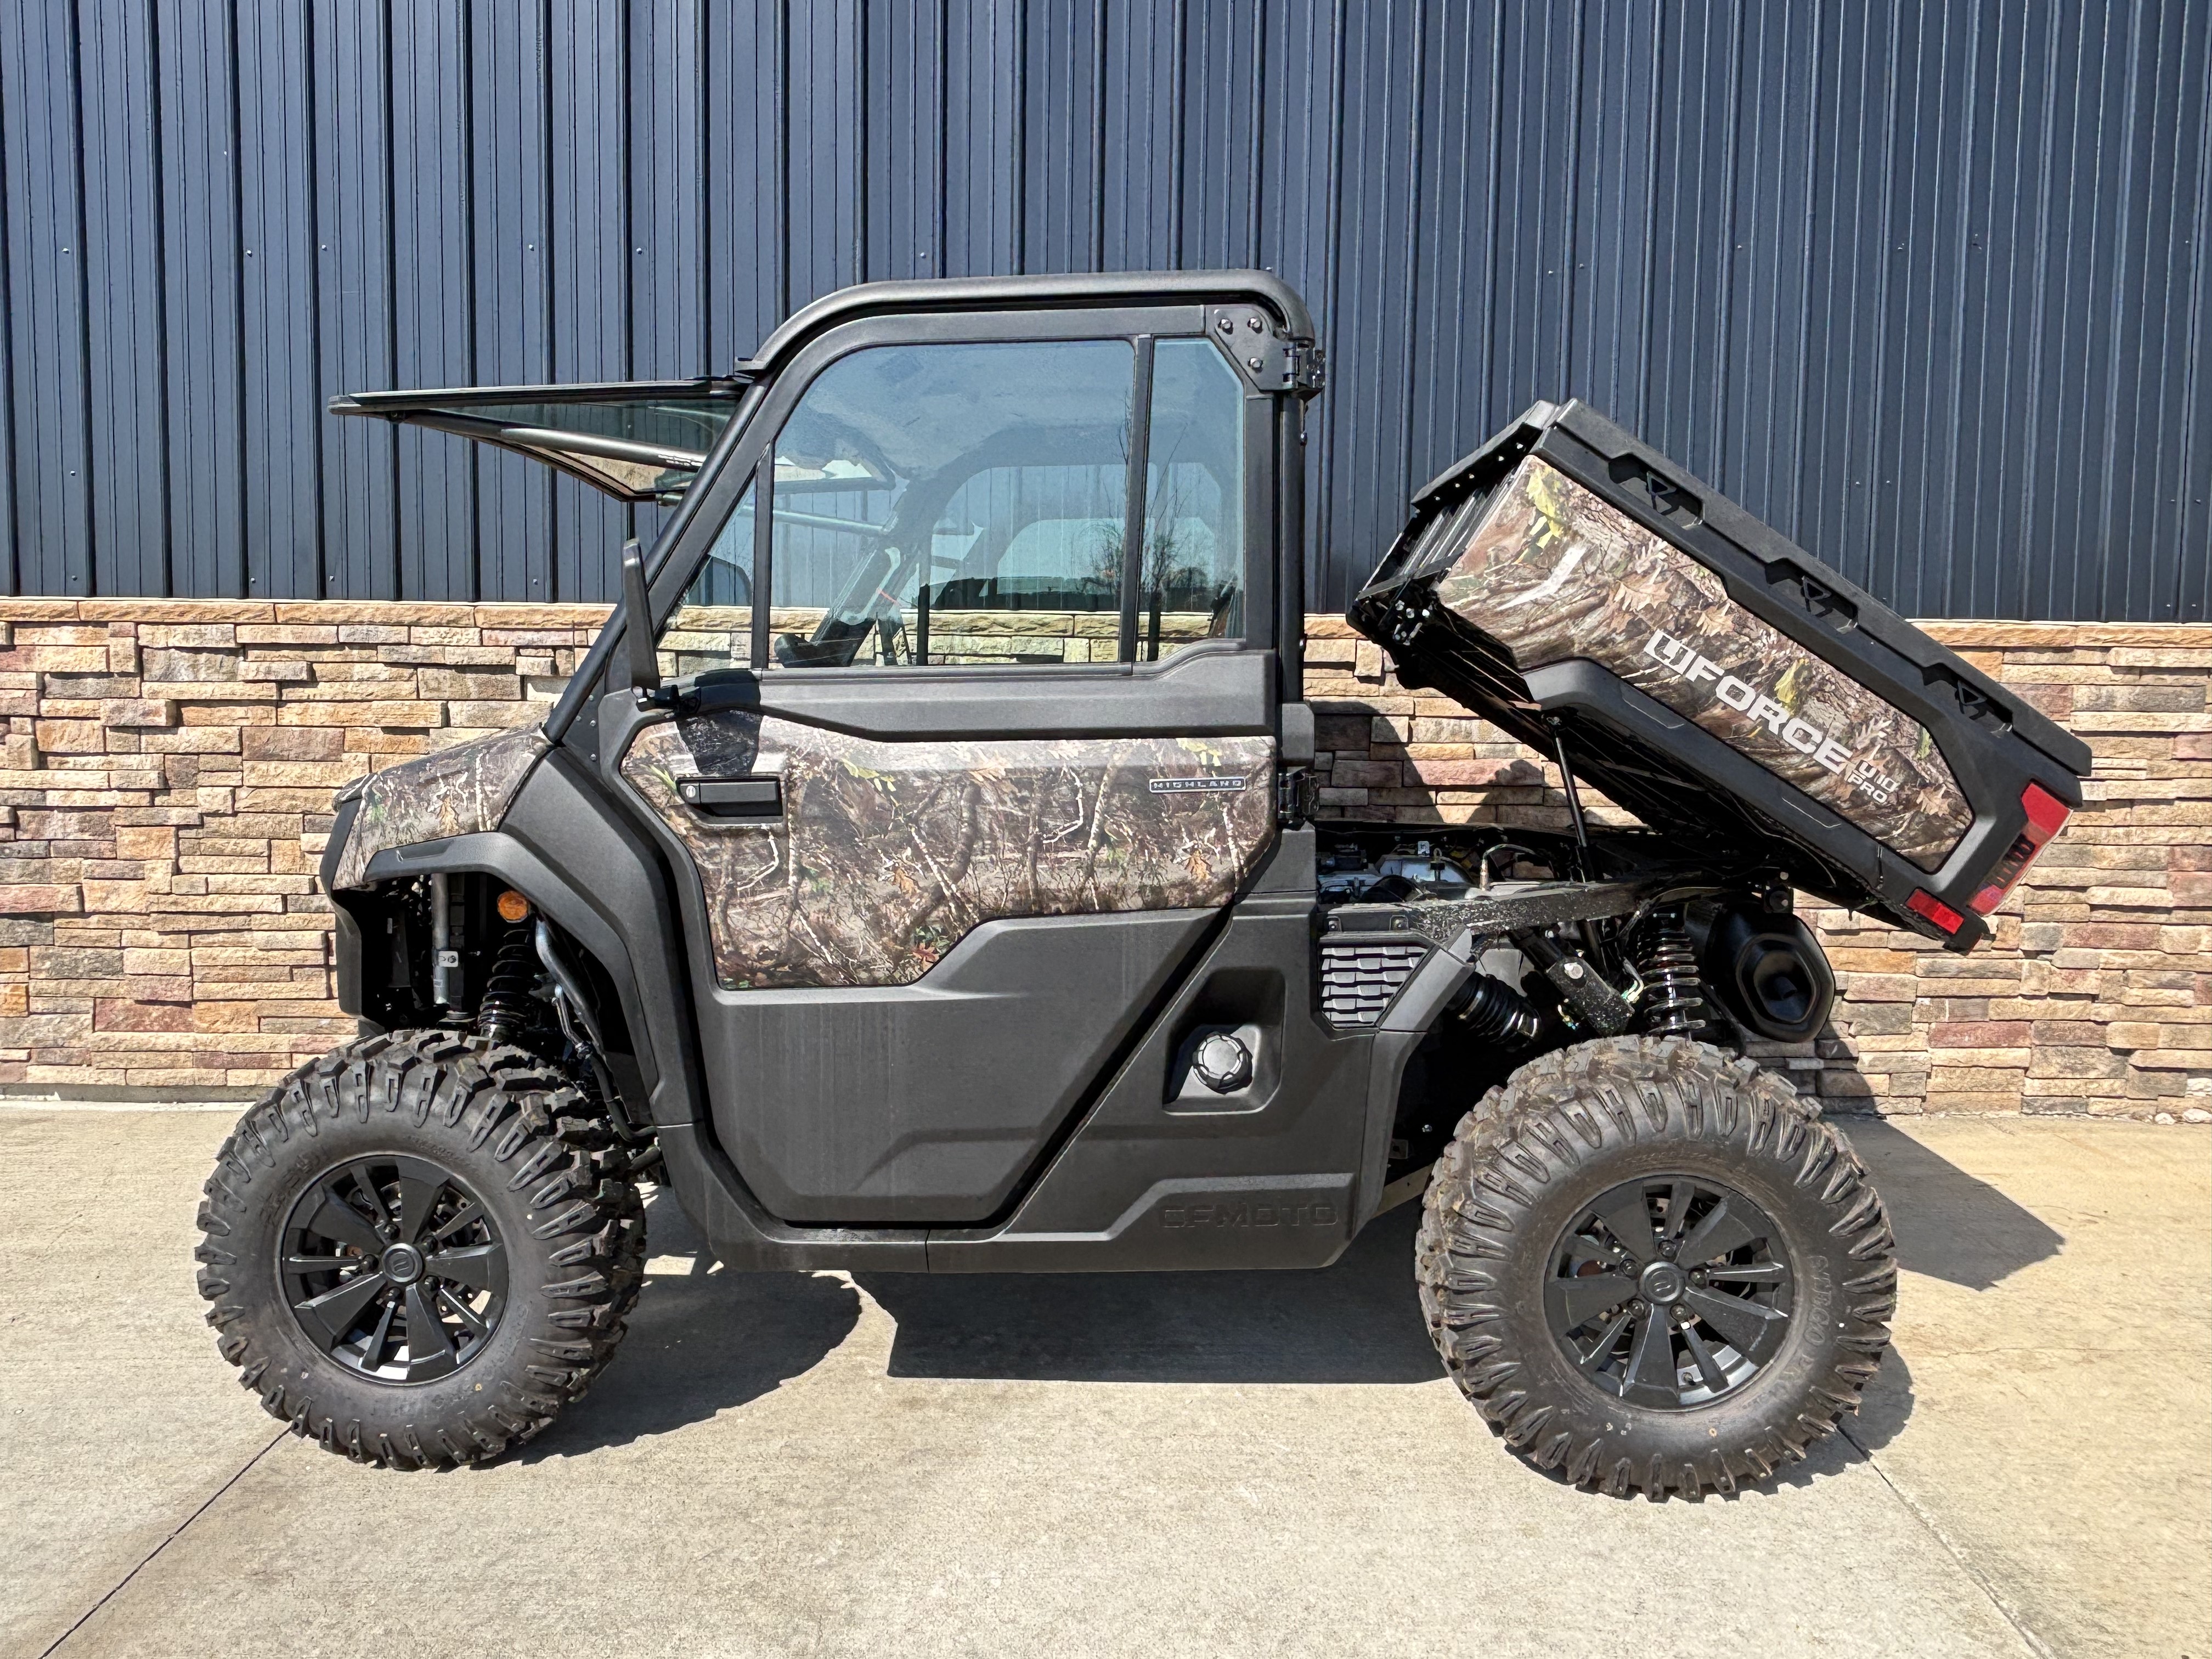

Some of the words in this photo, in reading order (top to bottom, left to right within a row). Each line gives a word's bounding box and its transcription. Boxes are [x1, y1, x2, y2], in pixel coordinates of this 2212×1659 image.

[1644, 629, 1854, 775] UFORCE
[1153, 780, 1242, 789] HIGHLAND
[1847, 772, 1888, 804] PRO
[1858, 761, 1899, 793] U10
[1161, 1203, 1339, 1228] CFMOTO
